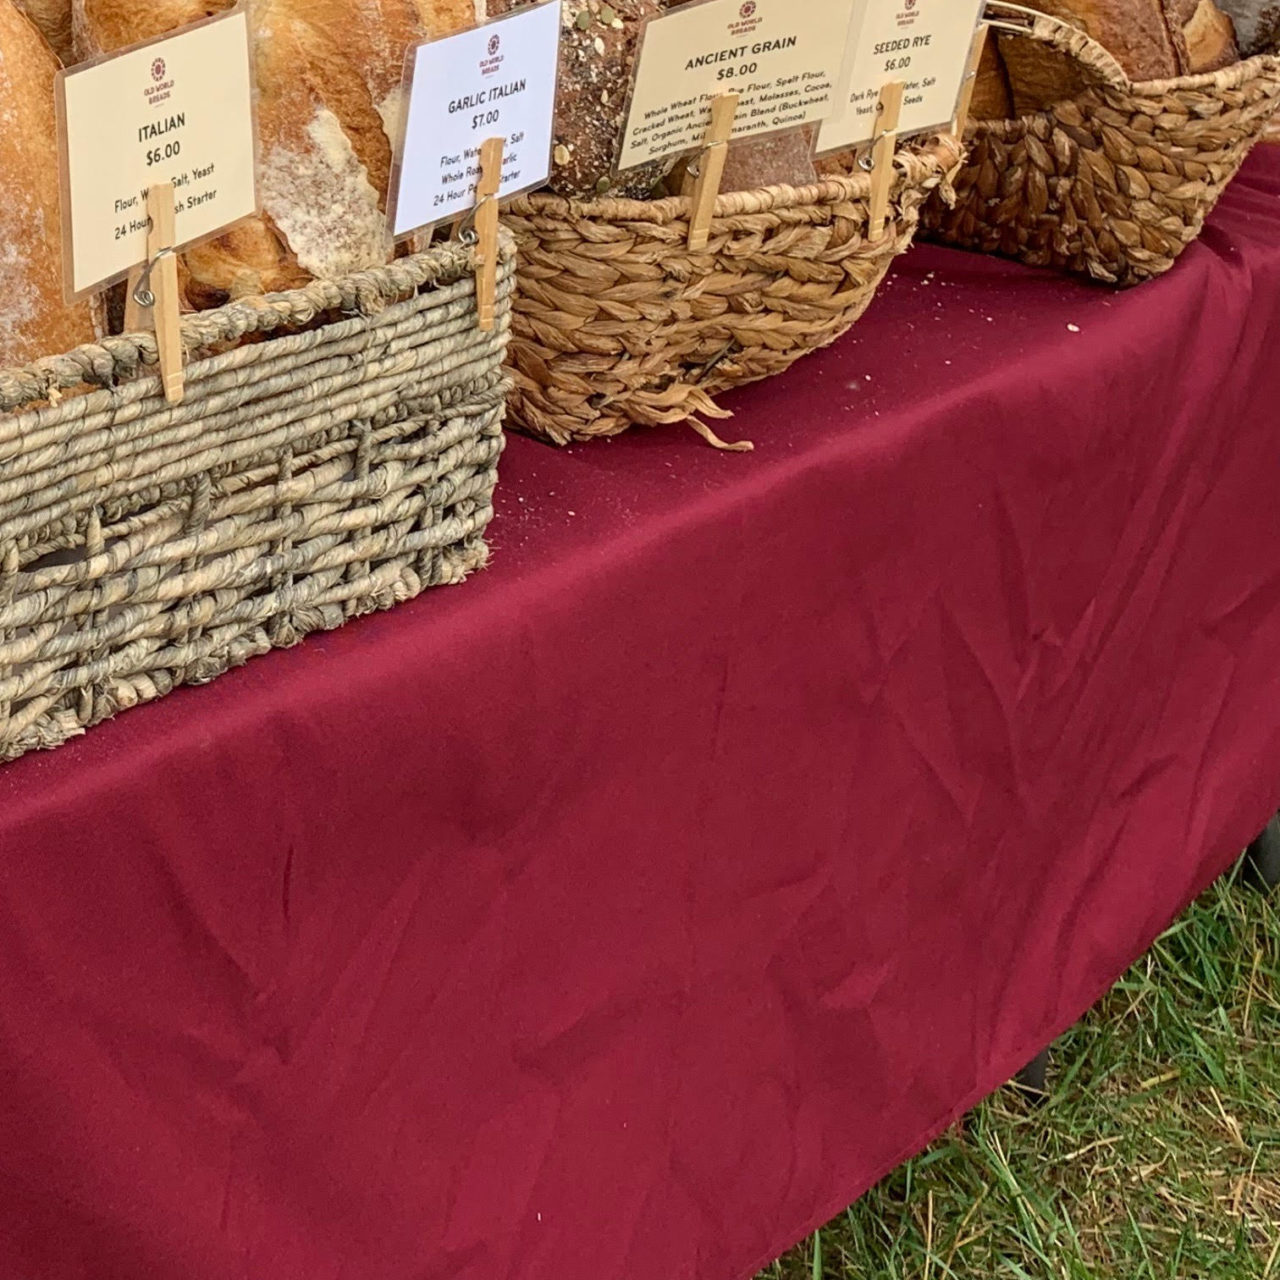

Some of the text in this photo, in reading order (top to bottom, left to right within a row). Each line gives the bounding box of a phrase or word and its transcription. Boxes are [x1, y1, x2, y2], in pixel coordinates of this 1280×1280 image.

[685, 35, 797, 71] ANCIENT GRAIN
[873, 34, 932, 55] SEEDED RYE
[716, 62, 758, 81] $8.00
[884, 56, 911, 71] $6.00
[144, 79, 175, 97] OLD WORLD
[448, 78, 527, 114] GARLIC ITALIAN
[644, 106, 668, 120] Whole
[670, 96, 697, 110] Wheat
[138, 112, 186, 143] ITALIAN
[471, 109, 500, 130] $7.00
[632, 118, 665, 136] Cracked
[651, 126, 683, 142] Organic
[750, 105, 777, 118] Blend
[146, 140, 181, 166] $6.00
[114, 196, 139, 214] Flour,
[192, 162, 215, 180] Yeast
[441, 171, 464, 185] Whole
[433, 194, 445, 207] 24
[446, 188, 466, 202] Hour
[114, 224, 127, 240] 24
[187, 190, 217, 209] Starter
